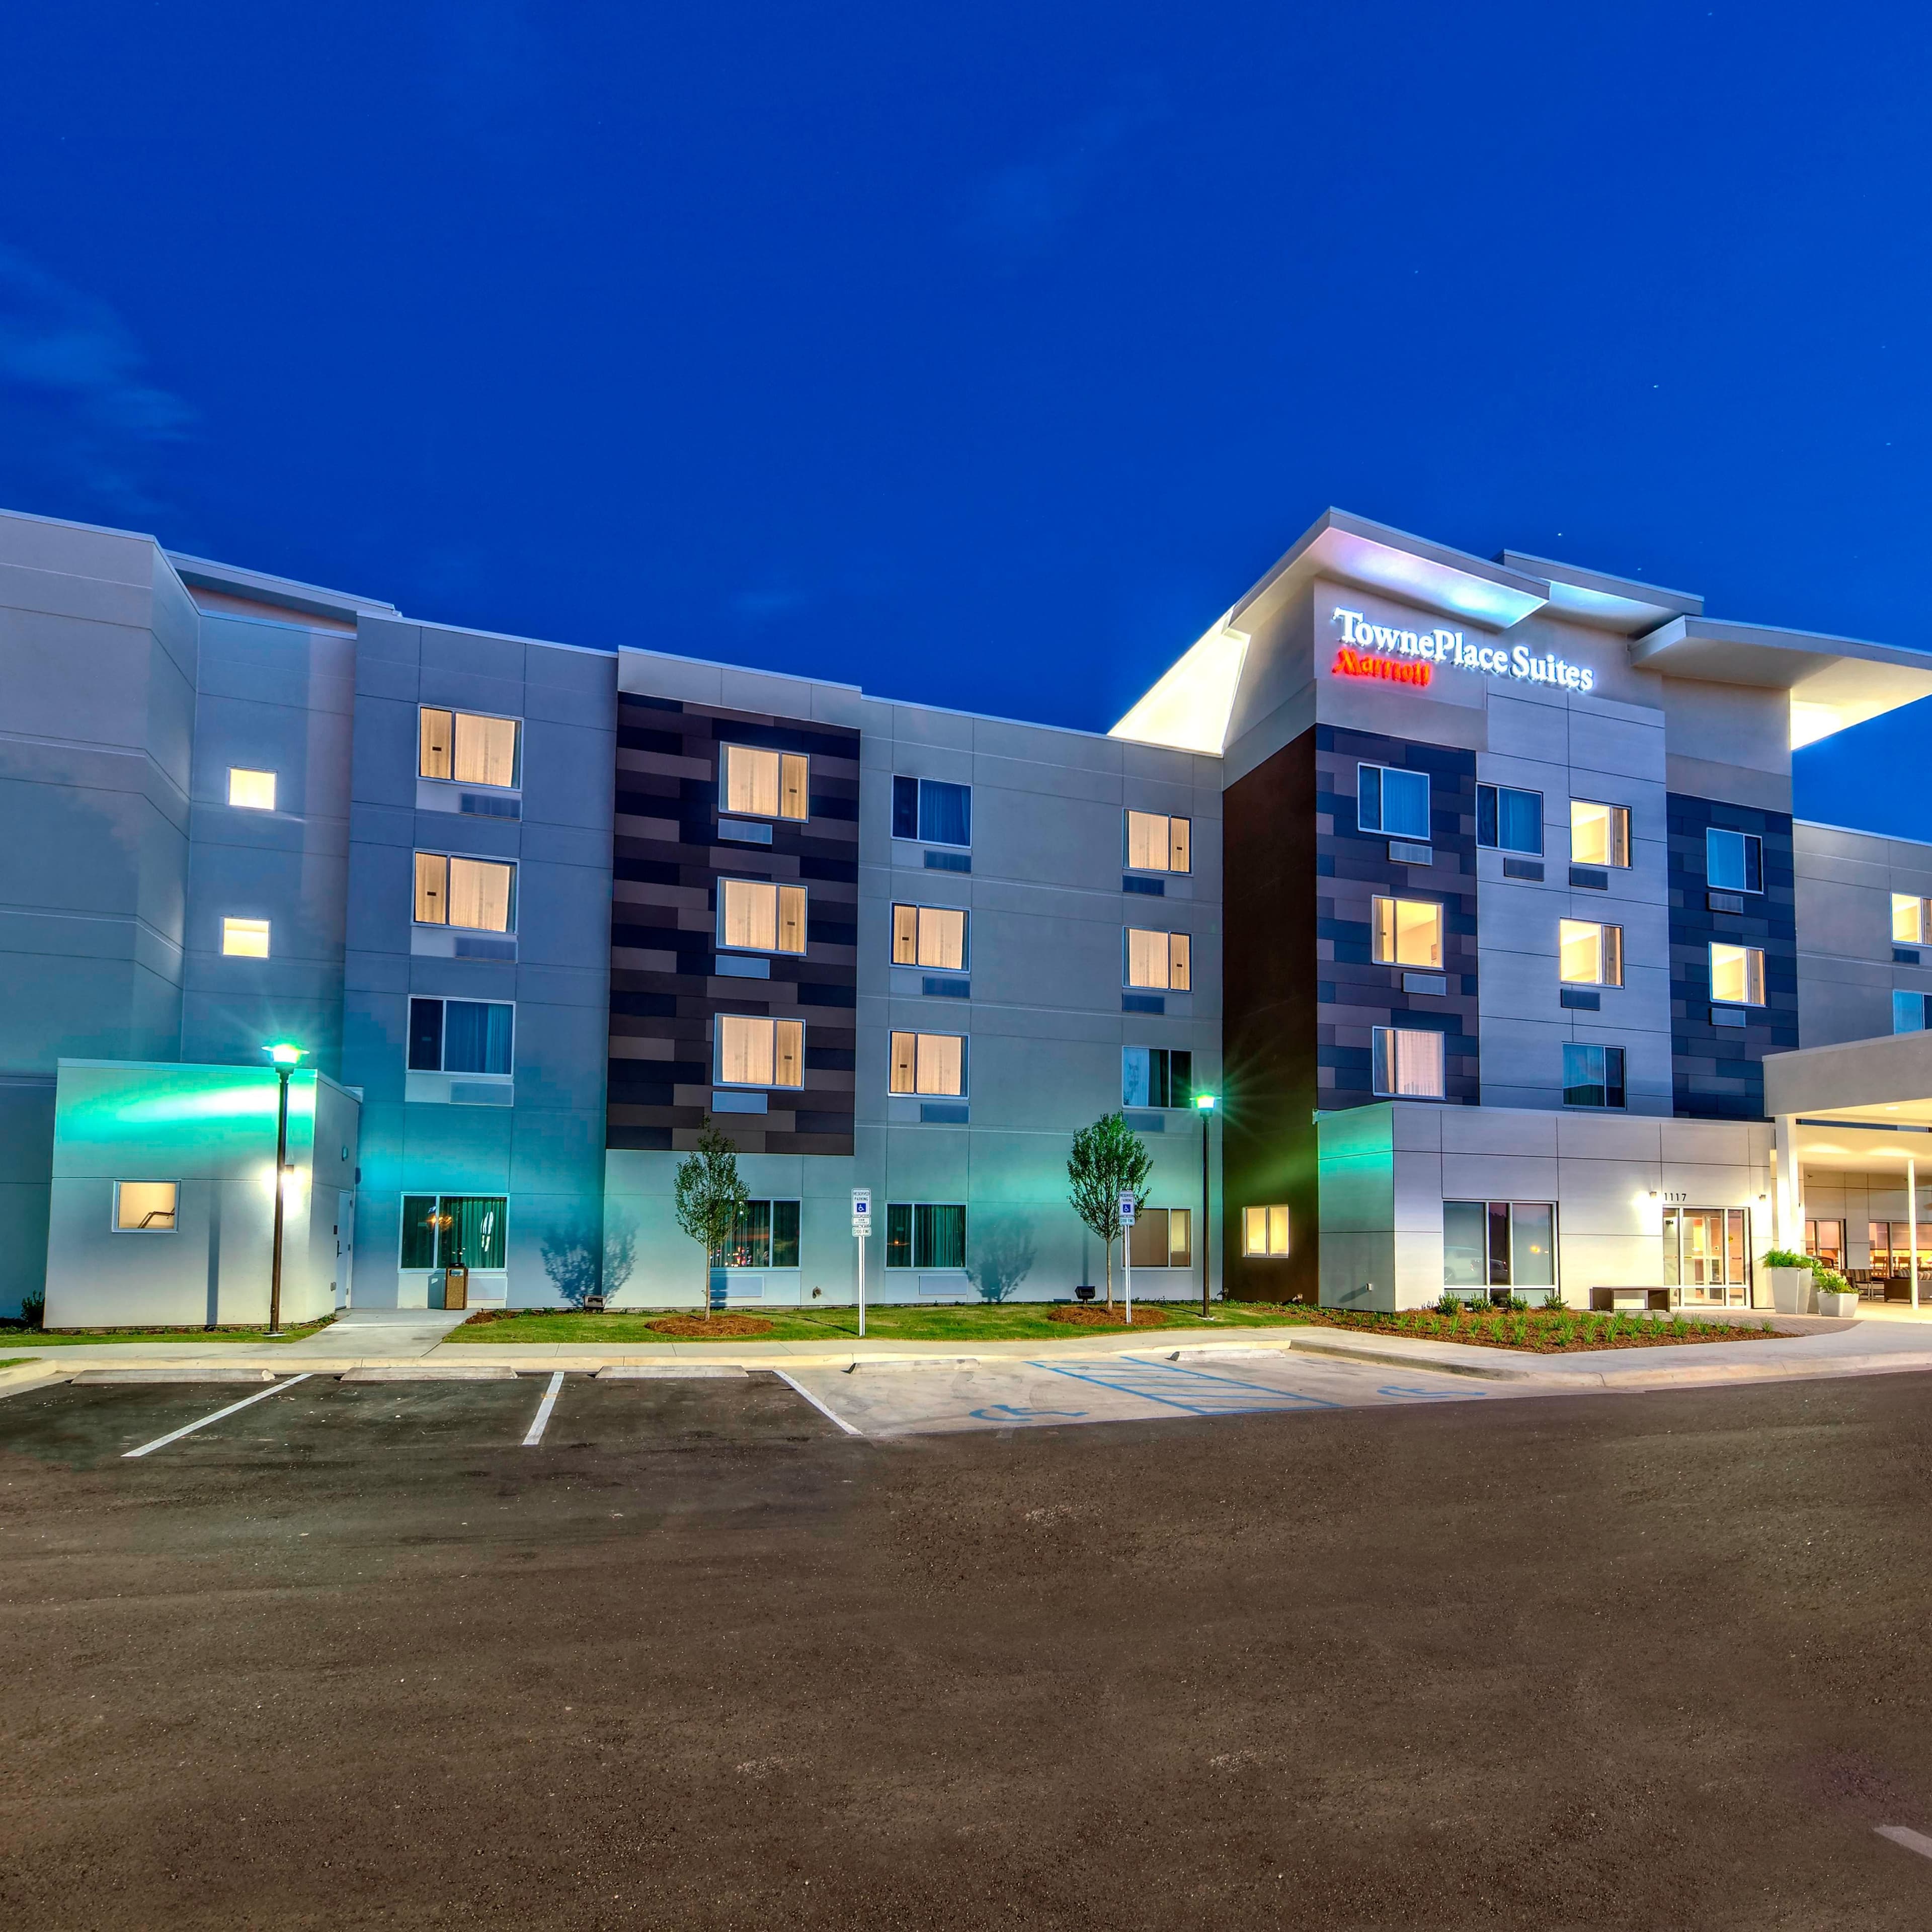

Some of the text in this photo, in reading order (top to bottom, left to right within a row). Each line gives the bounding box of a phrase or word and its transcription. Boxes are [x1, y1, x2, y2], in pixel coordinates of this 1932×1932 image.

[1333, 607, 1594, 690] TownePlace Suites
[1332, 649, 1430, 686] Marriott
[1664, 1192, 1686, 1201] 1117
